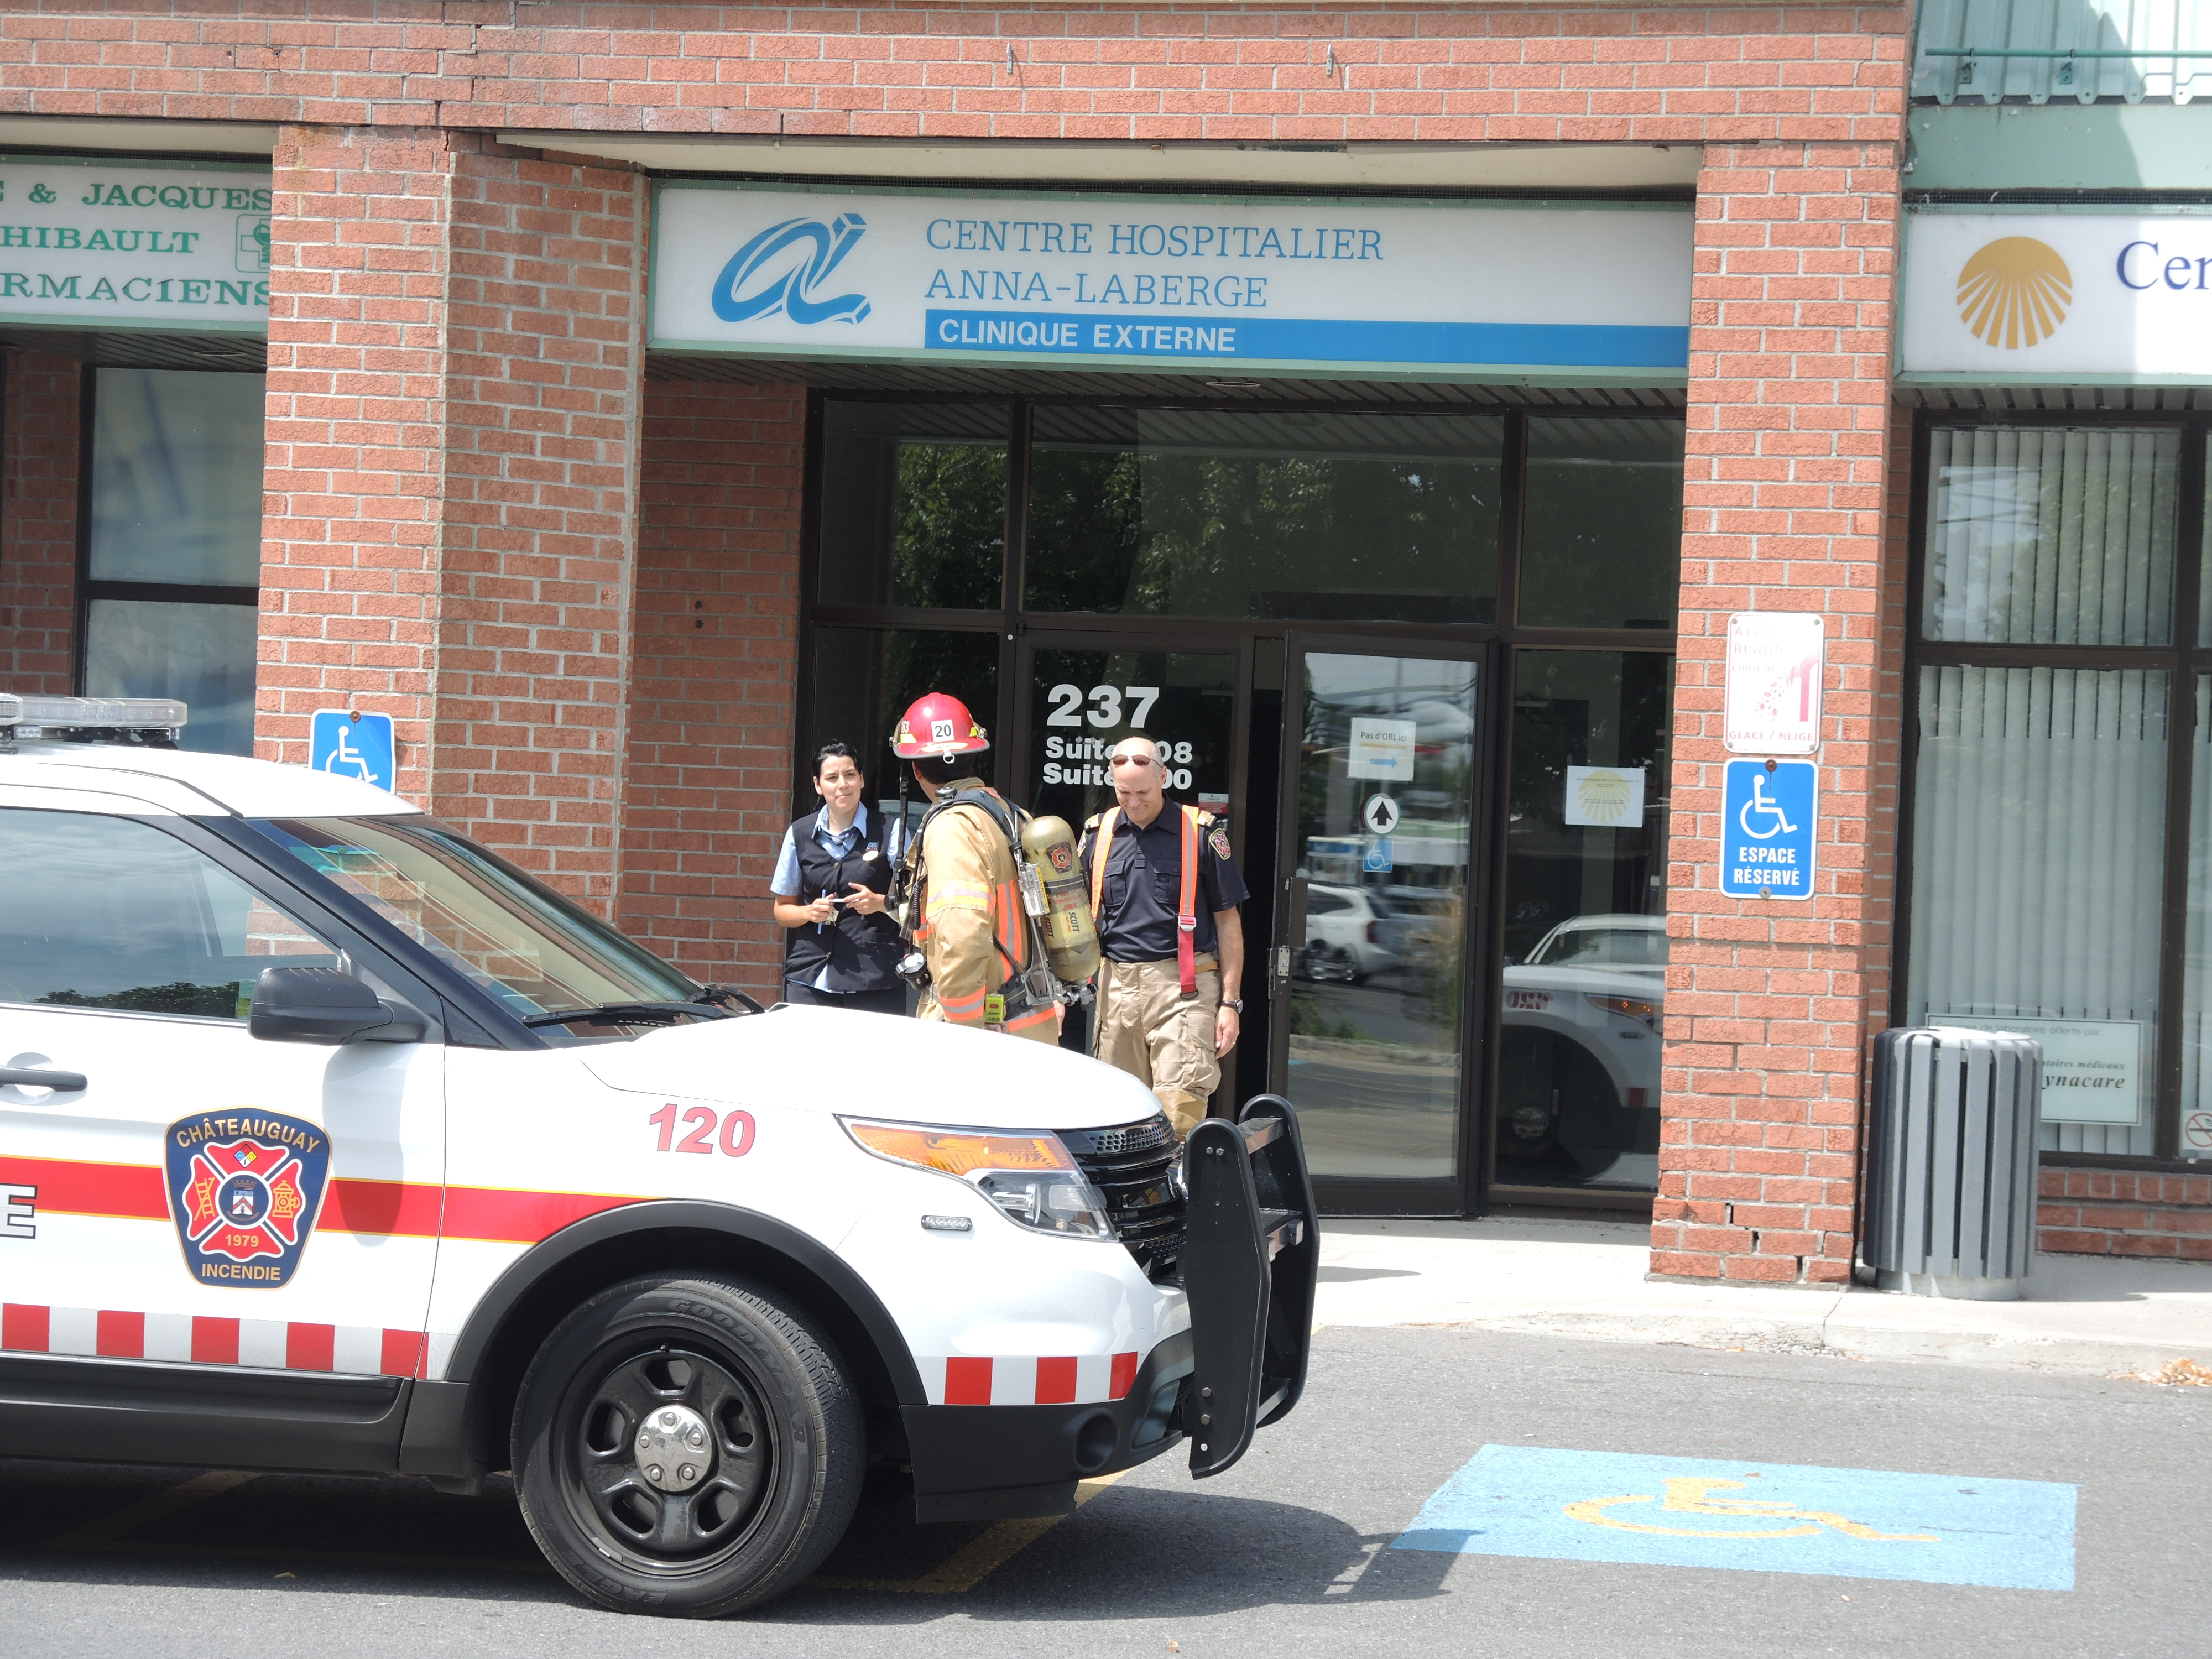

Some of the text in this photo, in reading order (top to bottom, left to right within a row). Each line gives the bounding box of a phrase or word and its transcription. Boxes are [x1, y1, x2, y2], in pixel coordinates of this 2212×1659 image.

[28, 182, 56, 204] &
[82, 184, 272, 211] JACQUES
[926, 218, 1384, 260] CENTRE HOSPITALIER
[924, 269, 1269, 307] ANNA-LABERGE
[938, 319, 1237, 352] CLINIQUE EXTERNE
[1046, 684, 1159, 728] 237
[934, 724, 952, 738] 20
[1360, 731, 1407, 742] Pas d'ORL ici
[1729, 731, 1765, 740] GLACE
[1778, 732, 1814, 742] NEIGE
[1155, 740, 1193, 764] 08
[1161, 768, 1192, 790] 00
[1739, 847, 1796, 864] ESPACE
[1733, 865, 1800, 886] RÉSERVÉ
[1044, 916, 1055, 938] SCOTT
[1068, 911, 1081, 933] SCOTT
[1996, 1024, 2046, 1034] laboratoire
[2049, 1026, 2080, 1035] offerts
[2077, 1060, 2126, 1070] médicaux
[176, 1117, 320, 1154] CHÂTEAUGUAY
[649, 1103, 756, 1157] 120
[225, 1234, 259, 1248] 1979
[202, 1264, 281, 1281] INCENDIE
[667, 1298, 806, 1444] GOODYEAR
